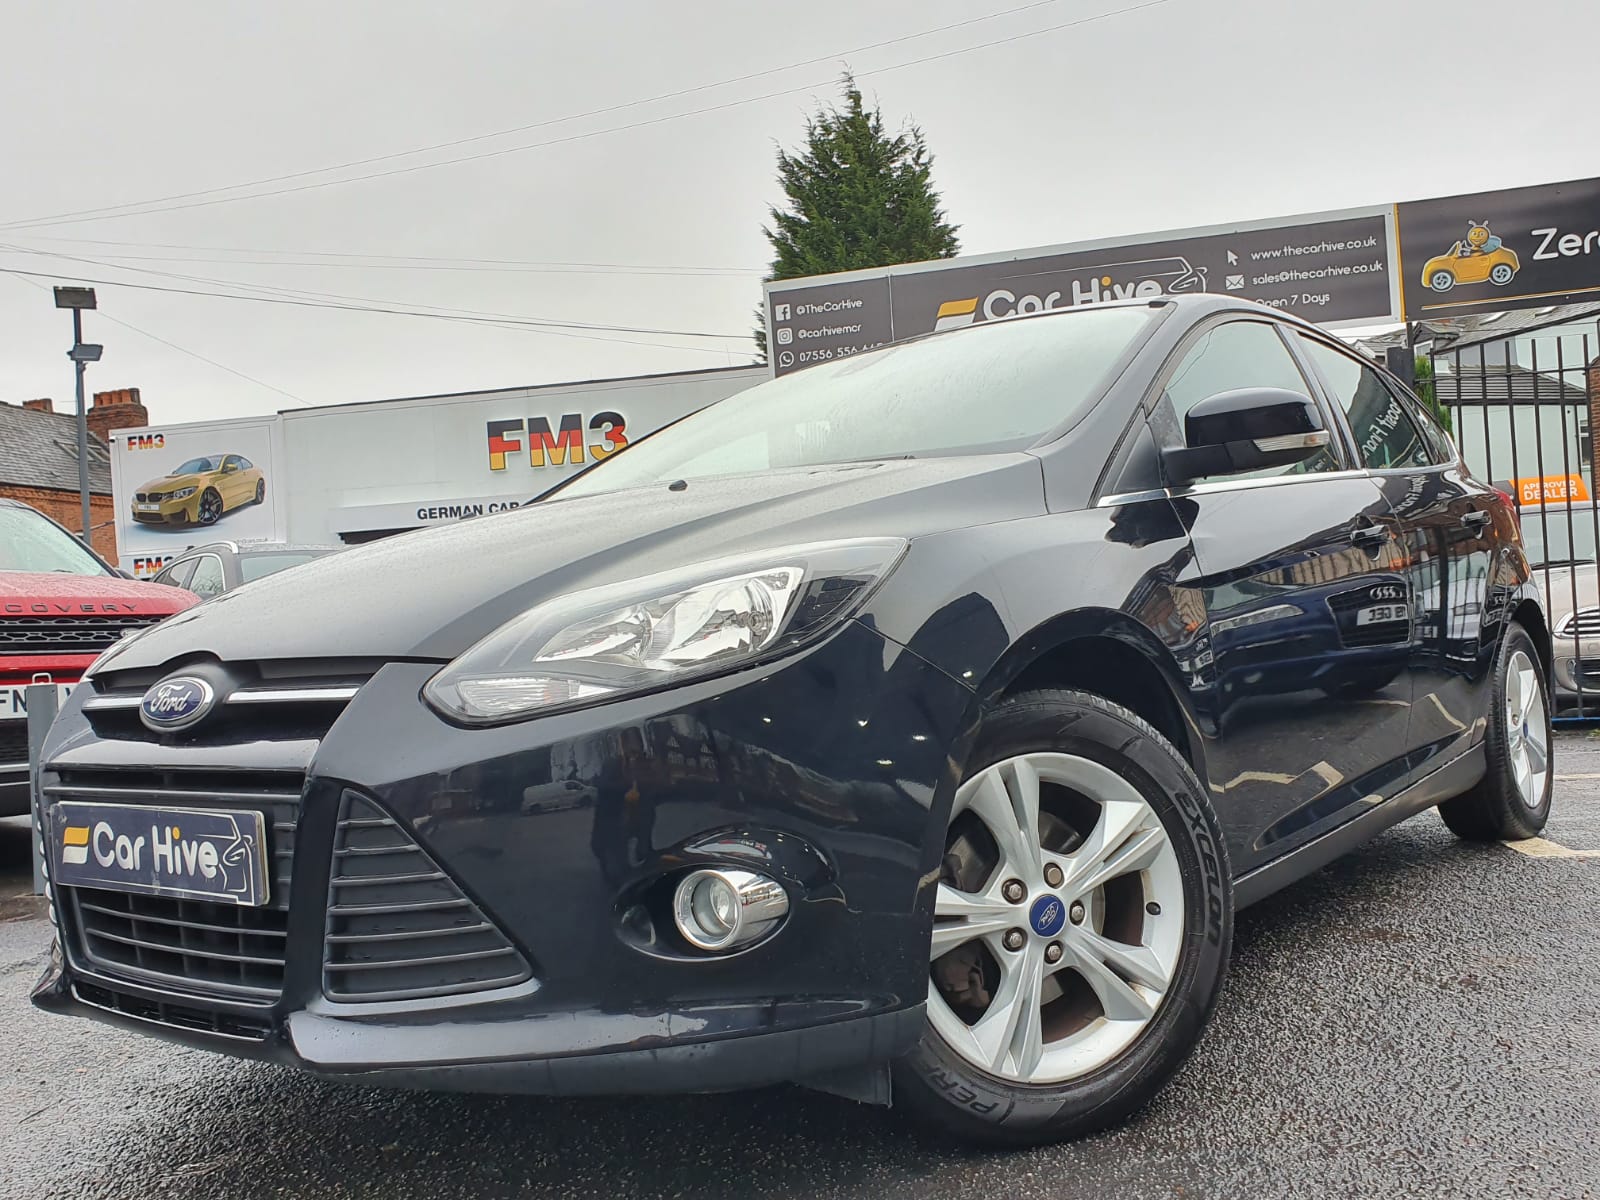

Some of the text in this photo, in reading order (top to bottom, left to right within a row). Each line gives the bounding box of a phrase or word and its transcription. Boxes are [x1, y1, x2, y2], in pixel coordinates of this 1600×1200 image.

[1250, 236, 1377, 261] www.thecarhive.co.uk
[1531, 227, 1600, 260] Zer
[1252, 260, 1383, 285] sales@thecarhive.co.uk
[796, 299, 863, 315] @TheCarHive
[983, 276, 1162, 320] Car Hive
[1291, 295, 1298, 306] 7
[1302, 292, 1330, 306] Days
[798, 323, 862, 339] @carhivemcr
[799, 349, 833, 362] 07556
[127, 434, 165, 450] FM3
[487, 411, 629, 471] FM3
[1524, 487, 1579, 501] DEALER
[417, 504, 483, 520] GERMAN
[150, 684, 193, 713] Ford
[93, 821, 219, 879] Car Hive
